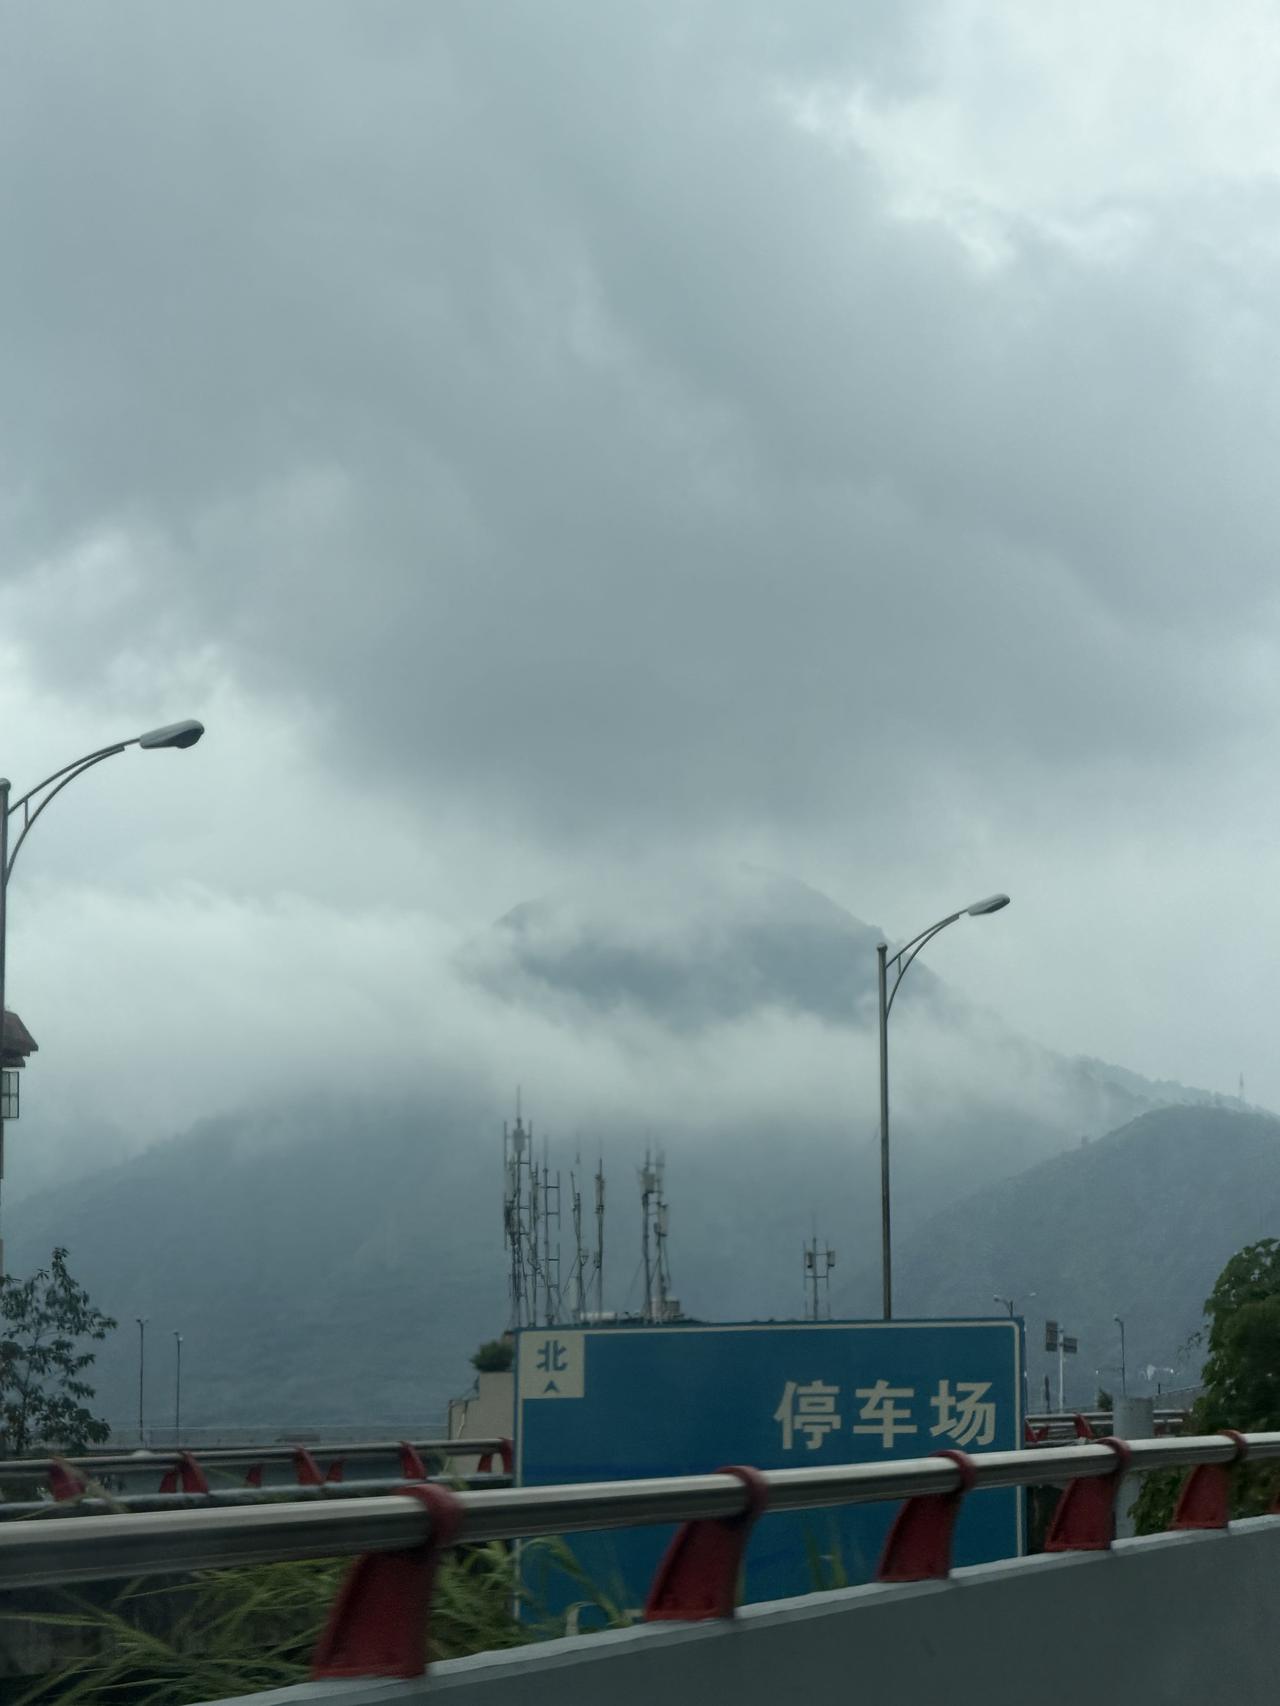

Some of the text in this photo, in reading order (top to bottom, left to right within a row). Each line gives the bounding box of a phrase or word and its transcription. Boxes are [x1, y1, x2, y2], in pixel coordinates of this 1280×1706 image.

[536, 1339, 567, 1372] 北
[774, 1379, 997, 1450] 停车场
